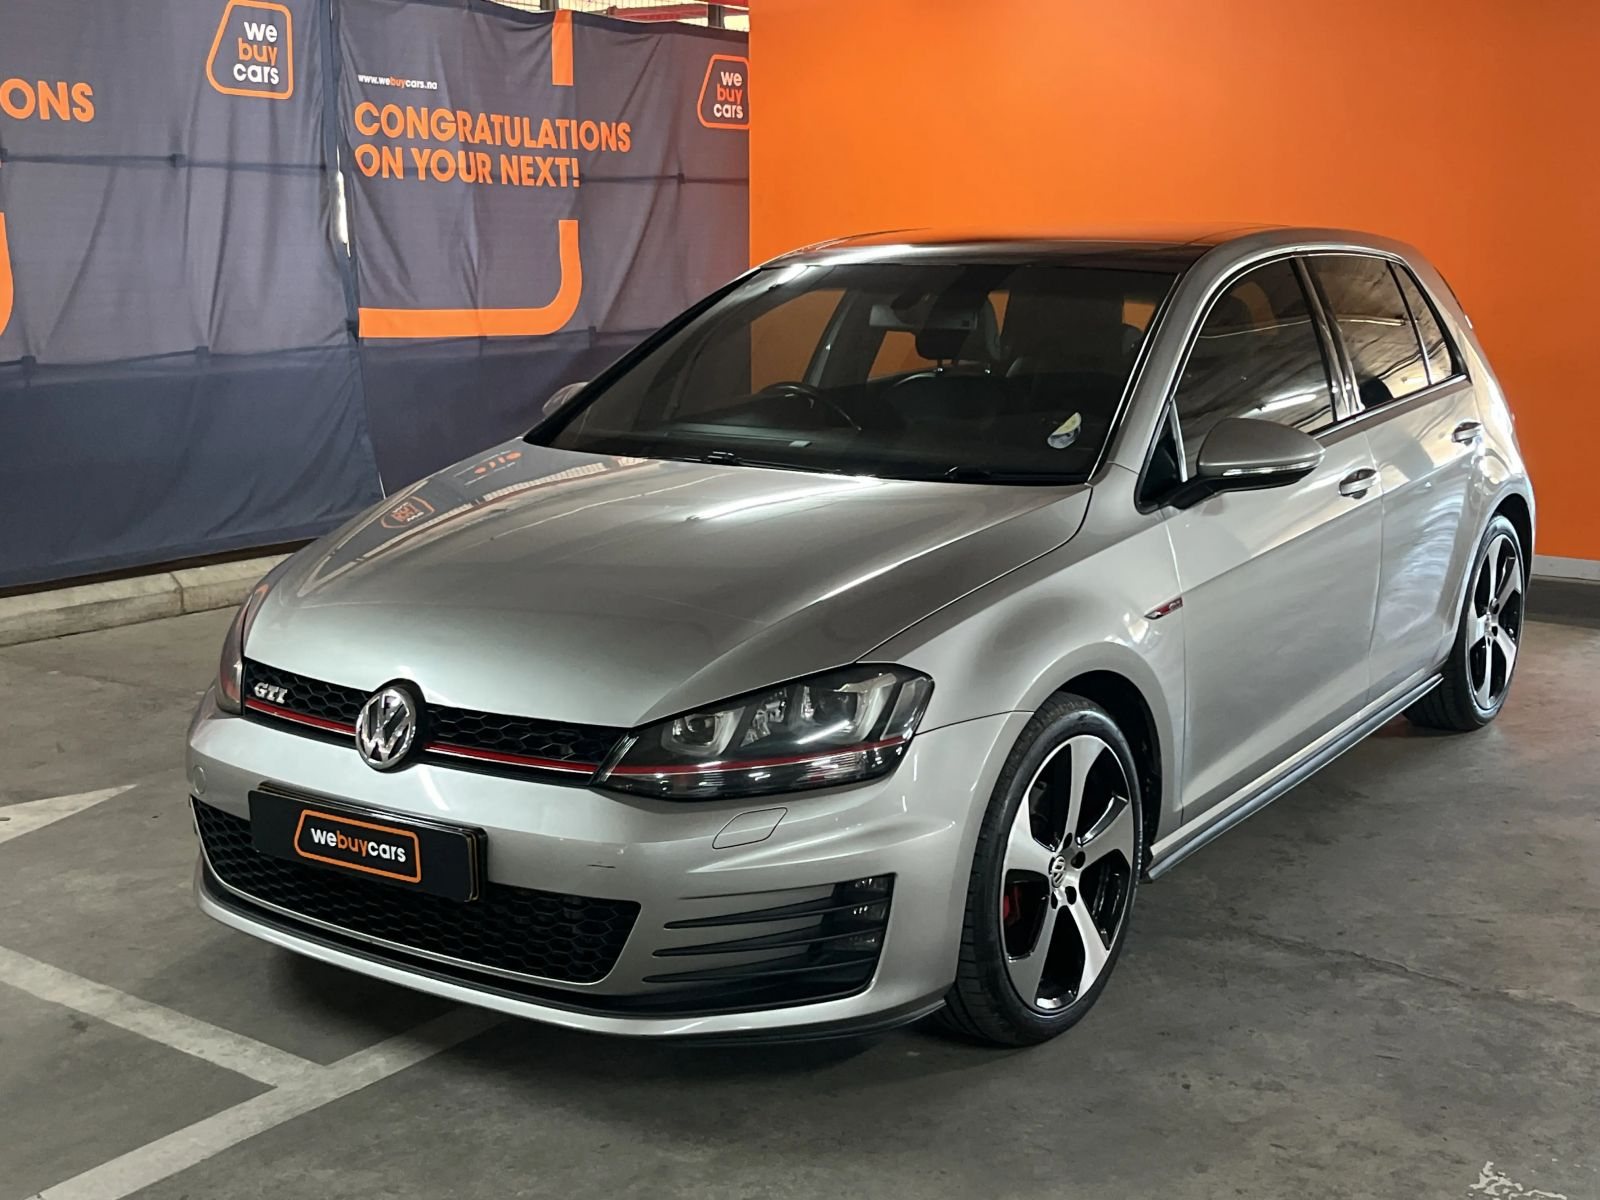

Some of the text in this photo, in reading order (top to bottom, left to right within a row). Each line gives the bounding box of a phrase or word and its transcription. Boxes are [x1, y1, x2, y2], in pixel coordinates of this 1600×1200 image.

[244, 21, 277, 42] we
[238, 38, 277, 66] buy
[233, 63, 279, 84] cars
[721, 72, 742, 86] we
[717, 83, 742, 105] buy
[713, 103, 743, 118] cars
[354, 101, 631, 152] CONGRATULATIONS
[354, 143, 580, 188] ON YOUR NEXT!
[253, 682, 288, 704] GTI
[310, 827, 406, 863] webuycars
